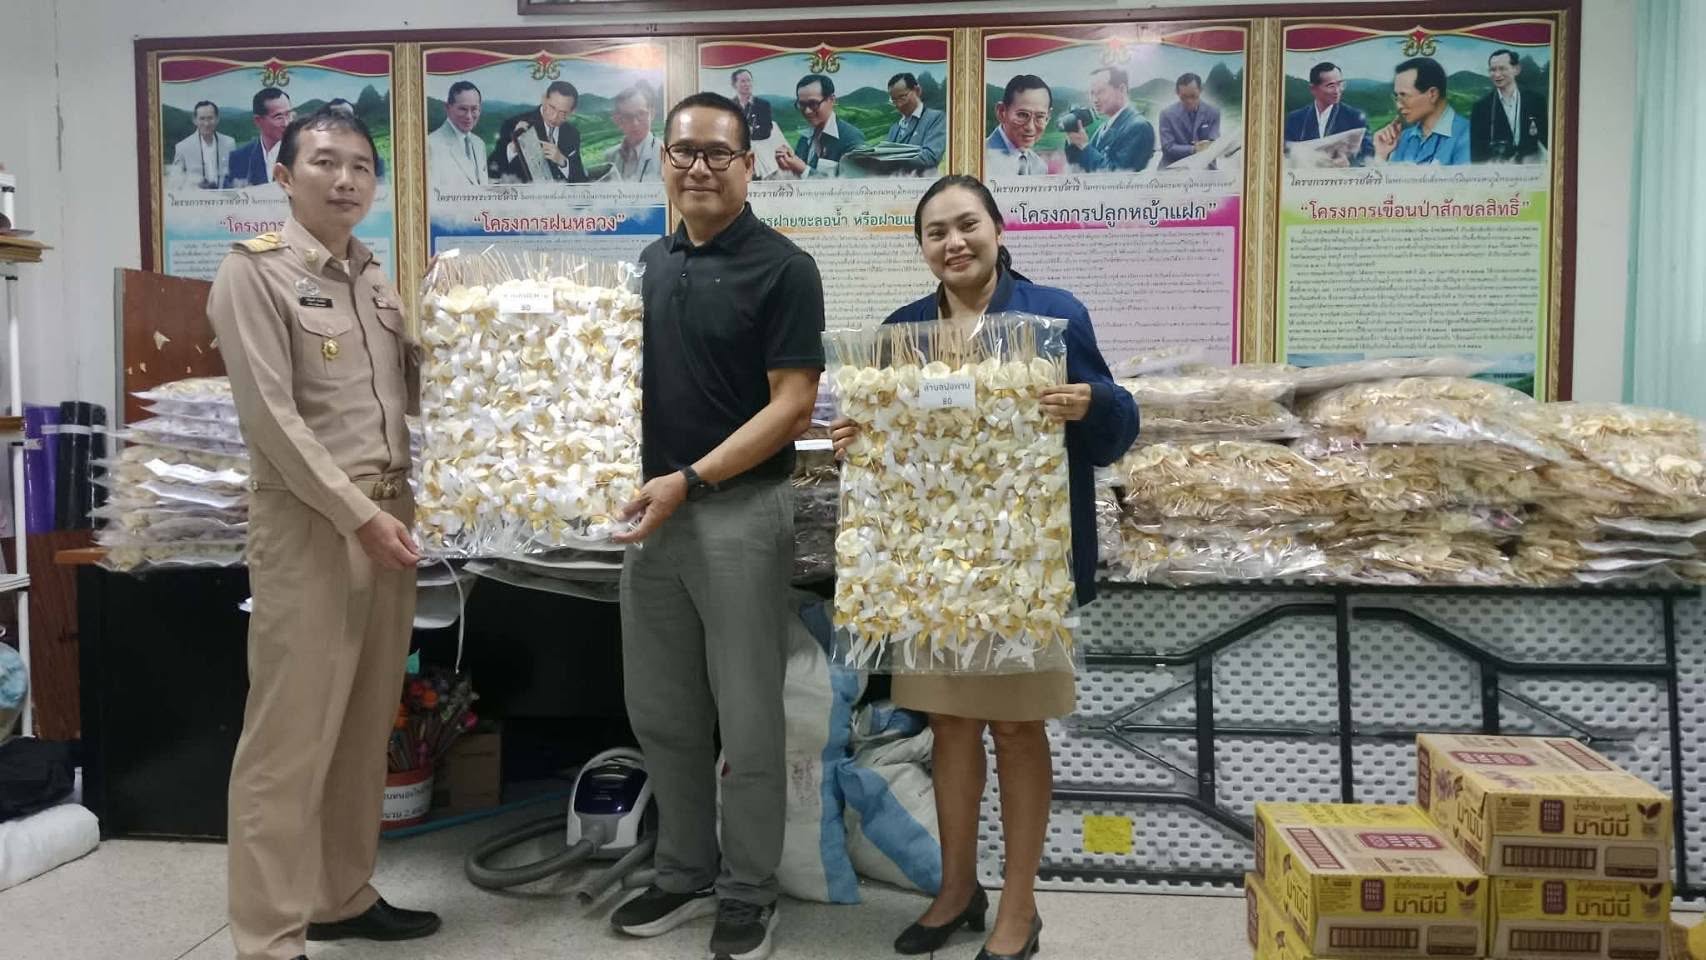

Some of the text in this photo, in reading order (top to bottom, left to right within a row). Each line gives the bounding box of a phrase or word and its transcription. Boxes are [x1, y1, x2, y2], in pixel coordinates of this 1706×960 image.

[1010, 200, 1217, 227] “โครงการปลูกหญ้าแฝก”
[1300, 192, 1530, 220] “โครงการเขื่อนป่าสักชลสิทธิ์”
[473, 211, 625, 232] “โครงการฝนหลวง”
[1573, 813, 1630, 837] มามีมี่
[1393, 891, 1447, 914] มามีมี่
[1575, 893, 1631, 917] มามีมี่
